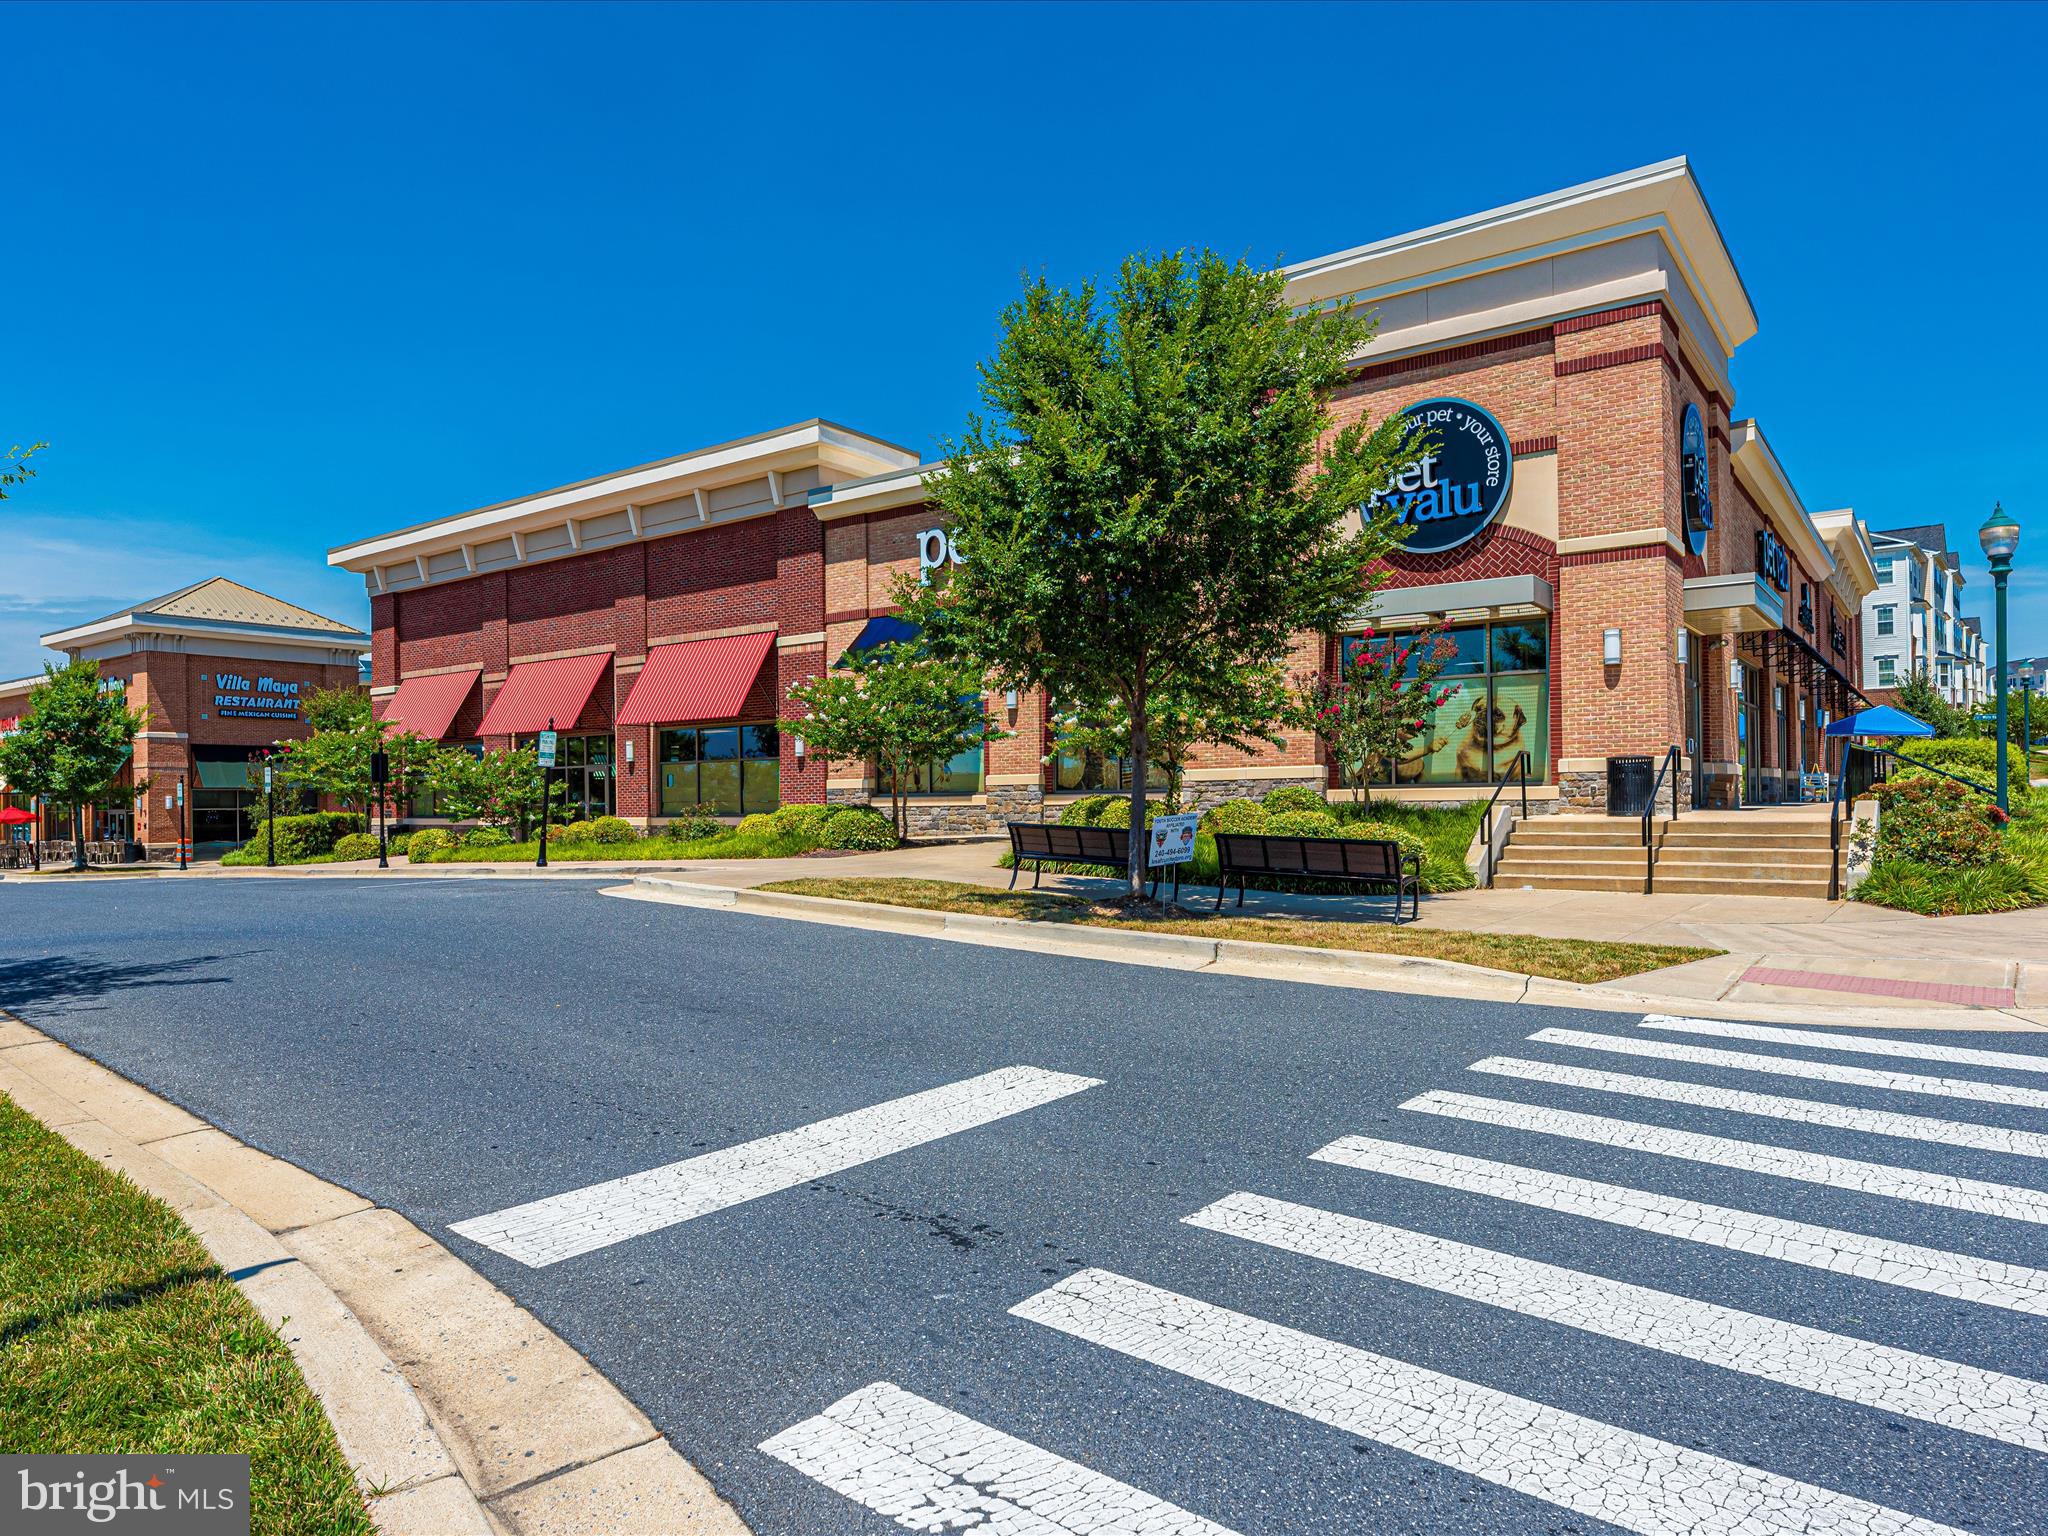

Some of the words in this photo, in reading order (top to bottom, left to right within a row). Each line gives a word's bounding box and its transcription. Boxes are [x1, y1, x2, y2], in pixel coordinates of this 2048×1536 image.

[1402, 412, 1424, 434] our
[1426, 407, 1453, 428] pet
[1459, 415, 1494, 446] your
[1485, 446, 1500, 487] store
[1385, 478, 1483, 525] valu
[214, 695, 300, 709] RESTAURANT
[216, 673, 251, 691] Villa
[257, 677, 298, 697] Maya
